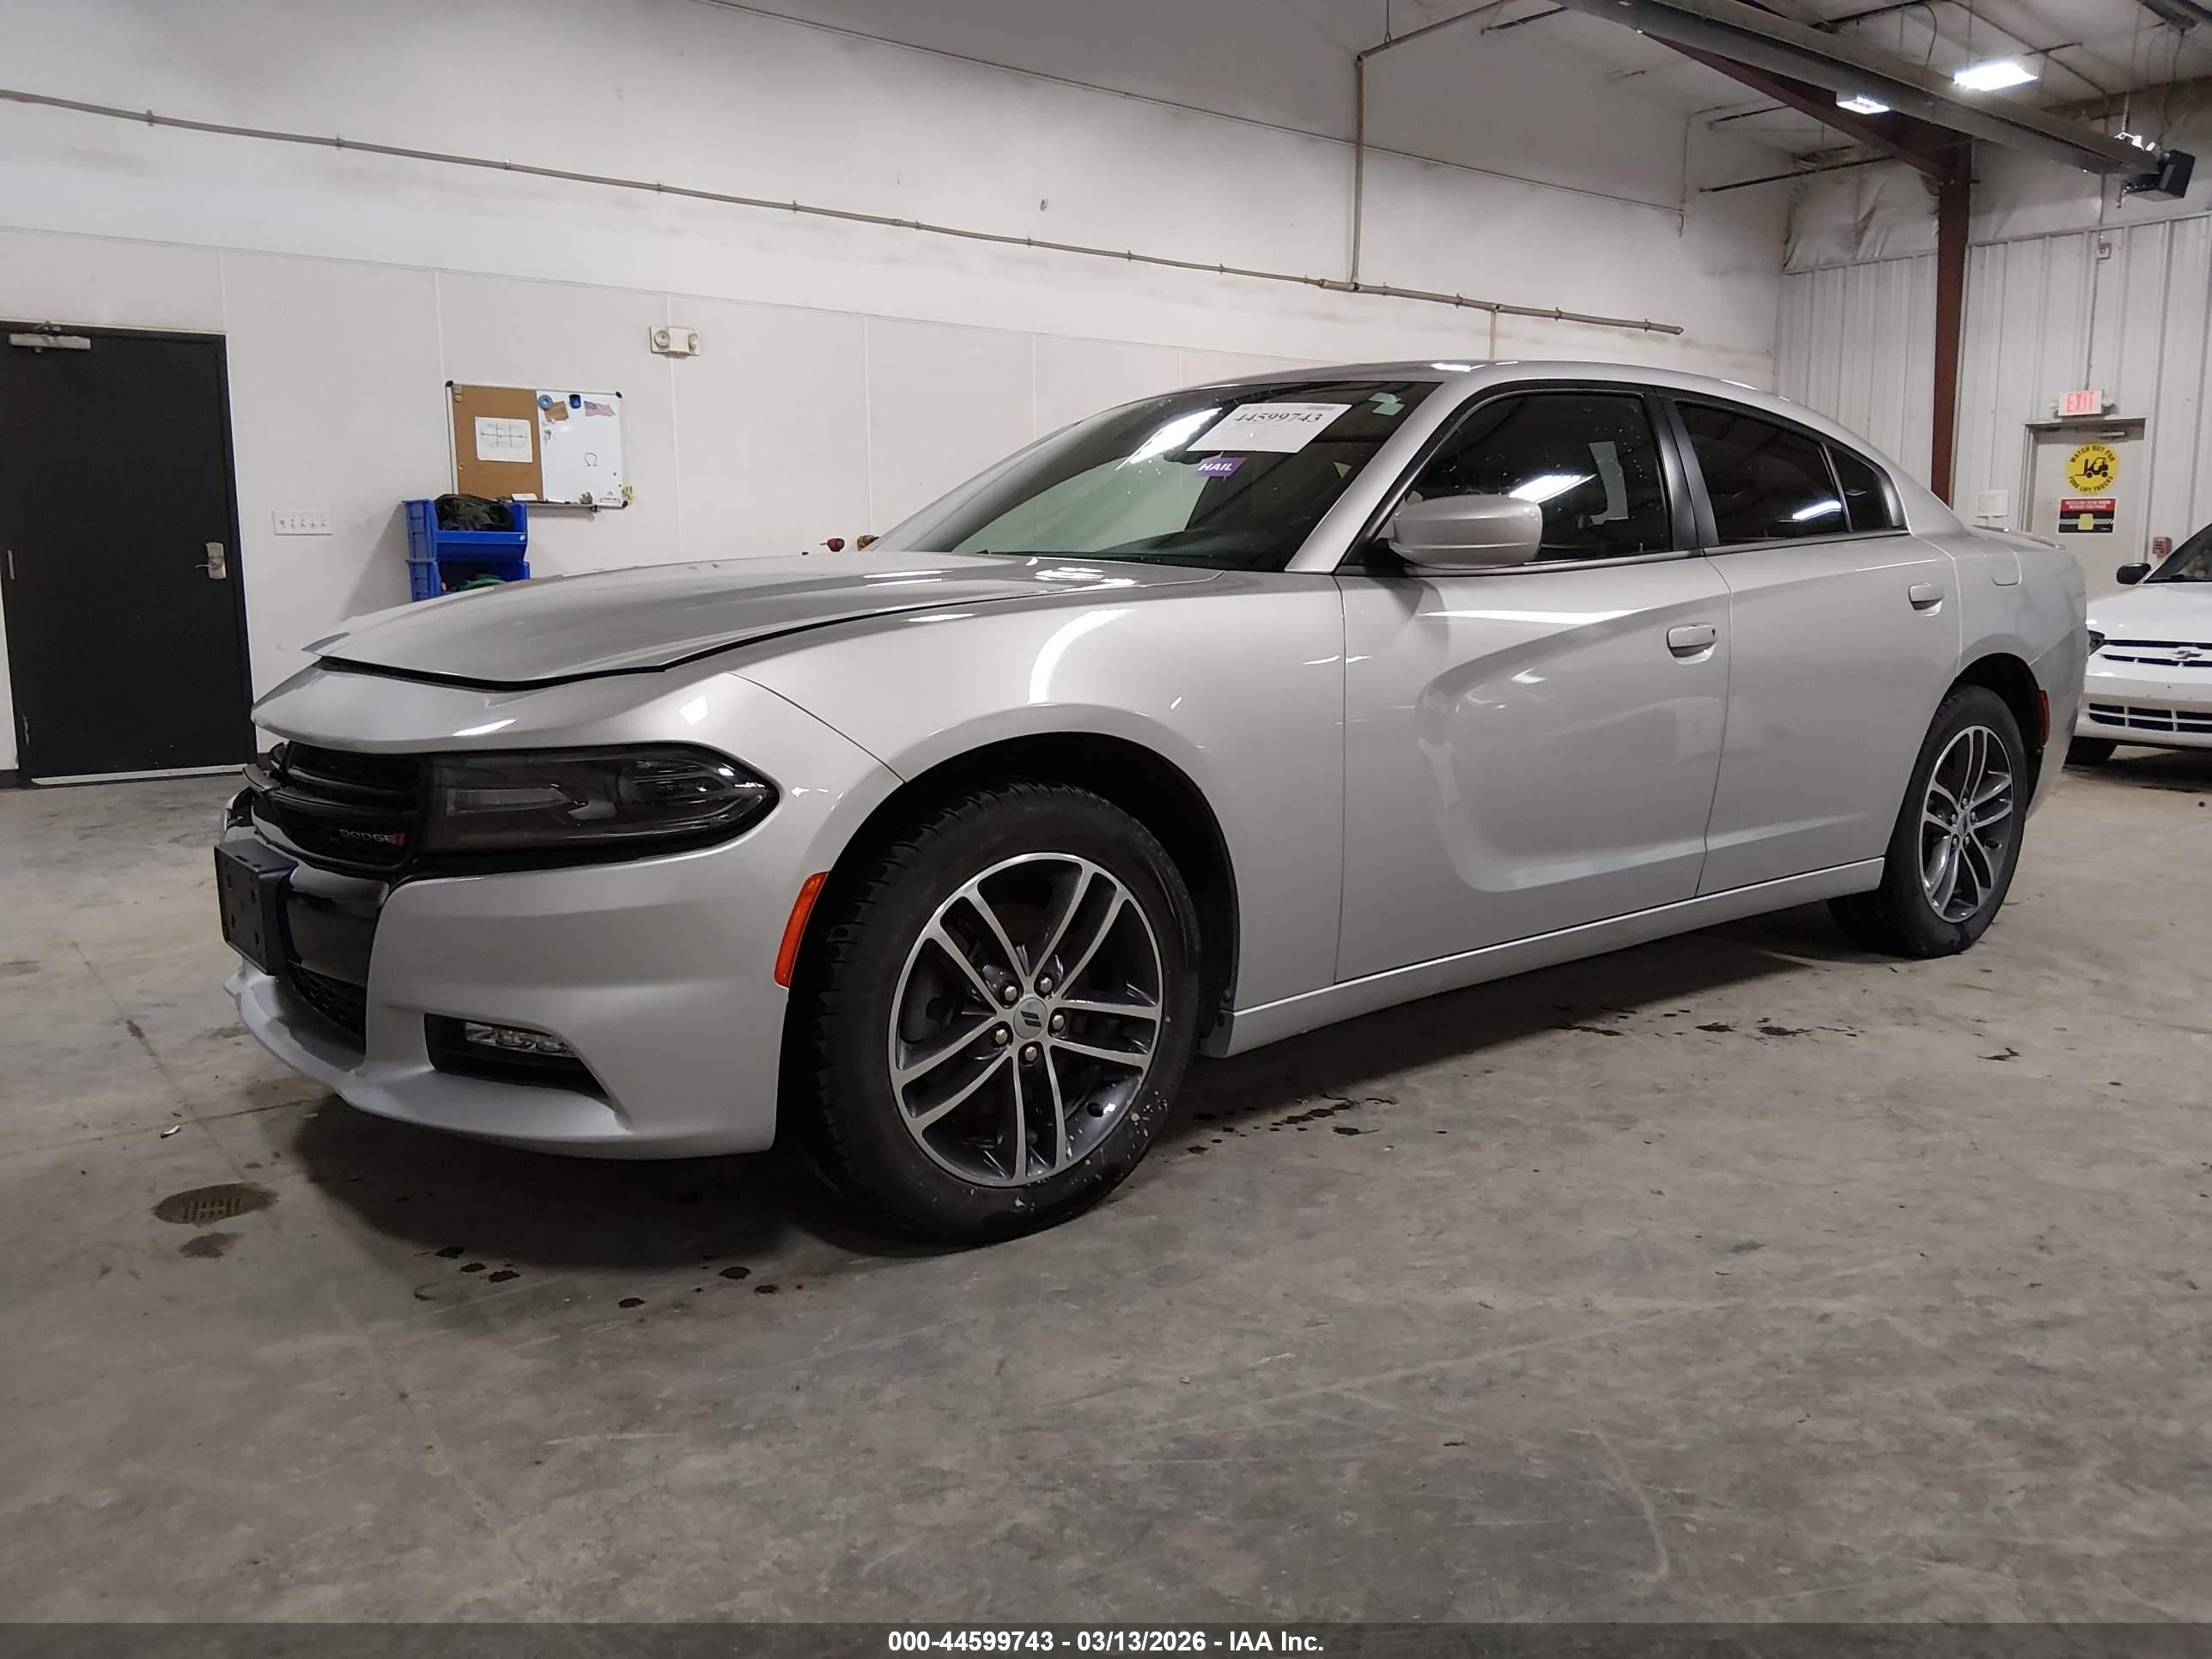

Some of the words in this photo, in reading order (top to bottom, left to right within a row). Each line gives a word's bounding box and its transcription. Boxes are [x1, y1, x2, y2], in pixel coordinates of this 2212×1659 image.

[2067, 391, 2095, 413] EXIT
[1233, 412, 1323, 422] 44599743
[2069, 446, 2090, 463] WATCH
[2104, 449, 2116, 462] FOR
[1197, 463, 1233, 471] HAIL
[2094, 476, 2114, 492] TRUCKS
[339, 828, 398, 844] DODGE
